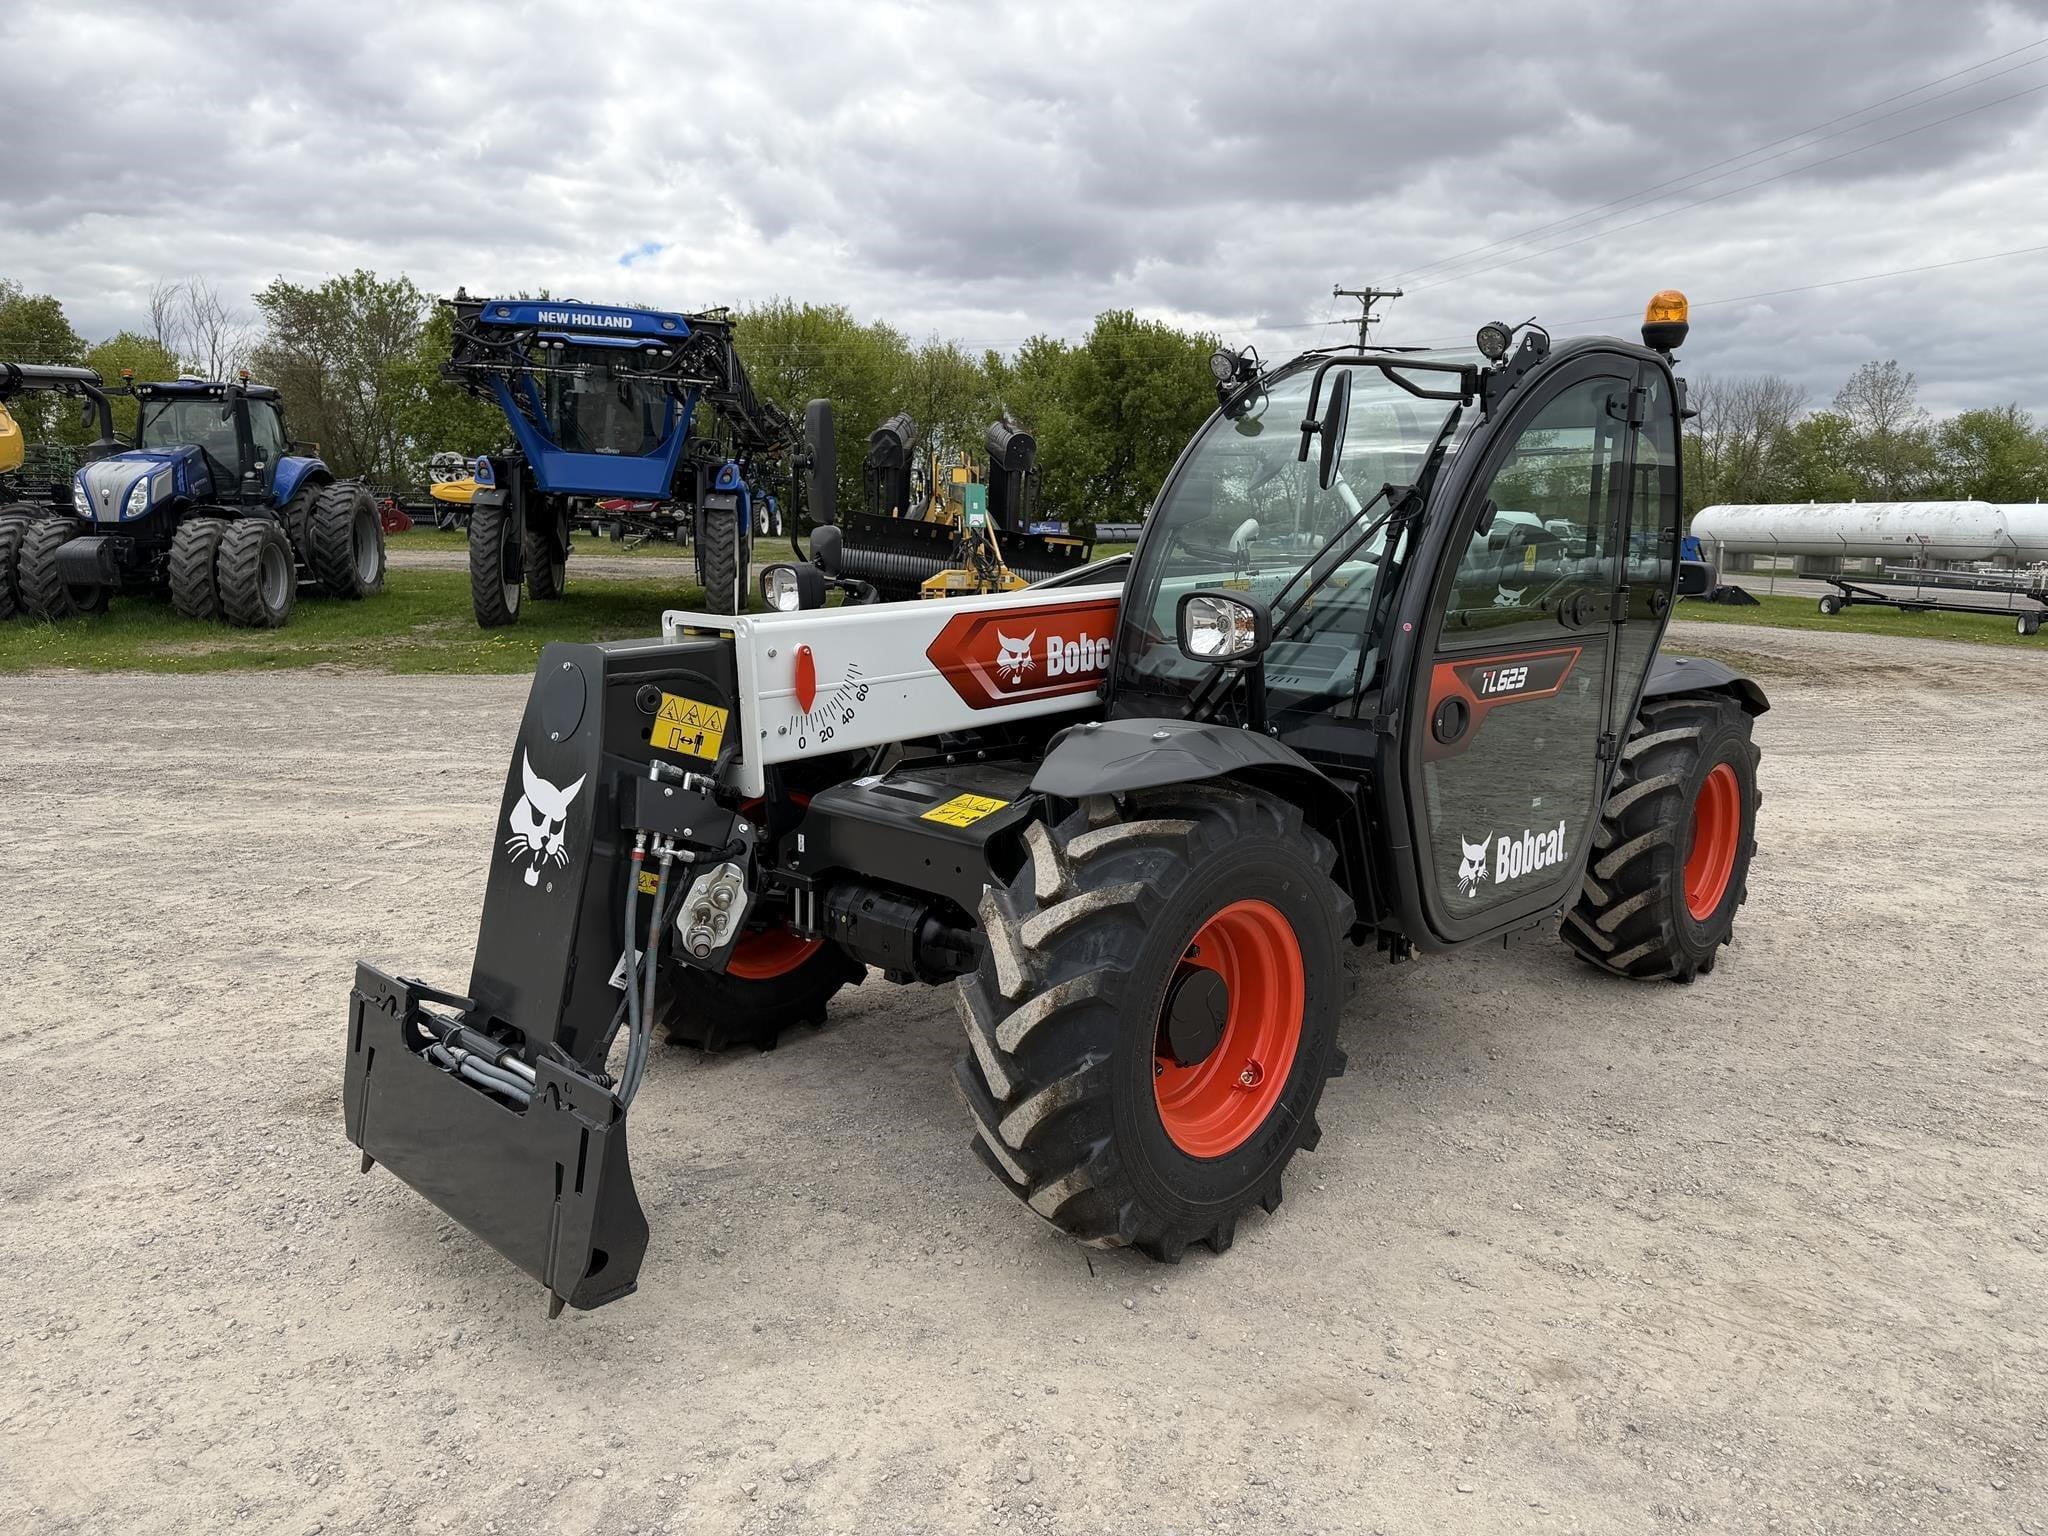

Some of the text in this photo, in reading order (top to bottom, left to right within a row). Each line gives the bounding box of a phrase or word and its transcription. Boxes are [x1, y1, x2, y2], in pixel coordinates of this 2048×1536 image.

[538, 311, 633, 328] NEW HOLLAND
[1046, 632, 1111, 677] Bobc
[856, 683, 869, 702] 60
[841, 707, 855, 725] 40
[798, 736, 806, 749] 0
[819, 726, 834, 743] 20
[1495, 820, 1566, 884] Bobcat
